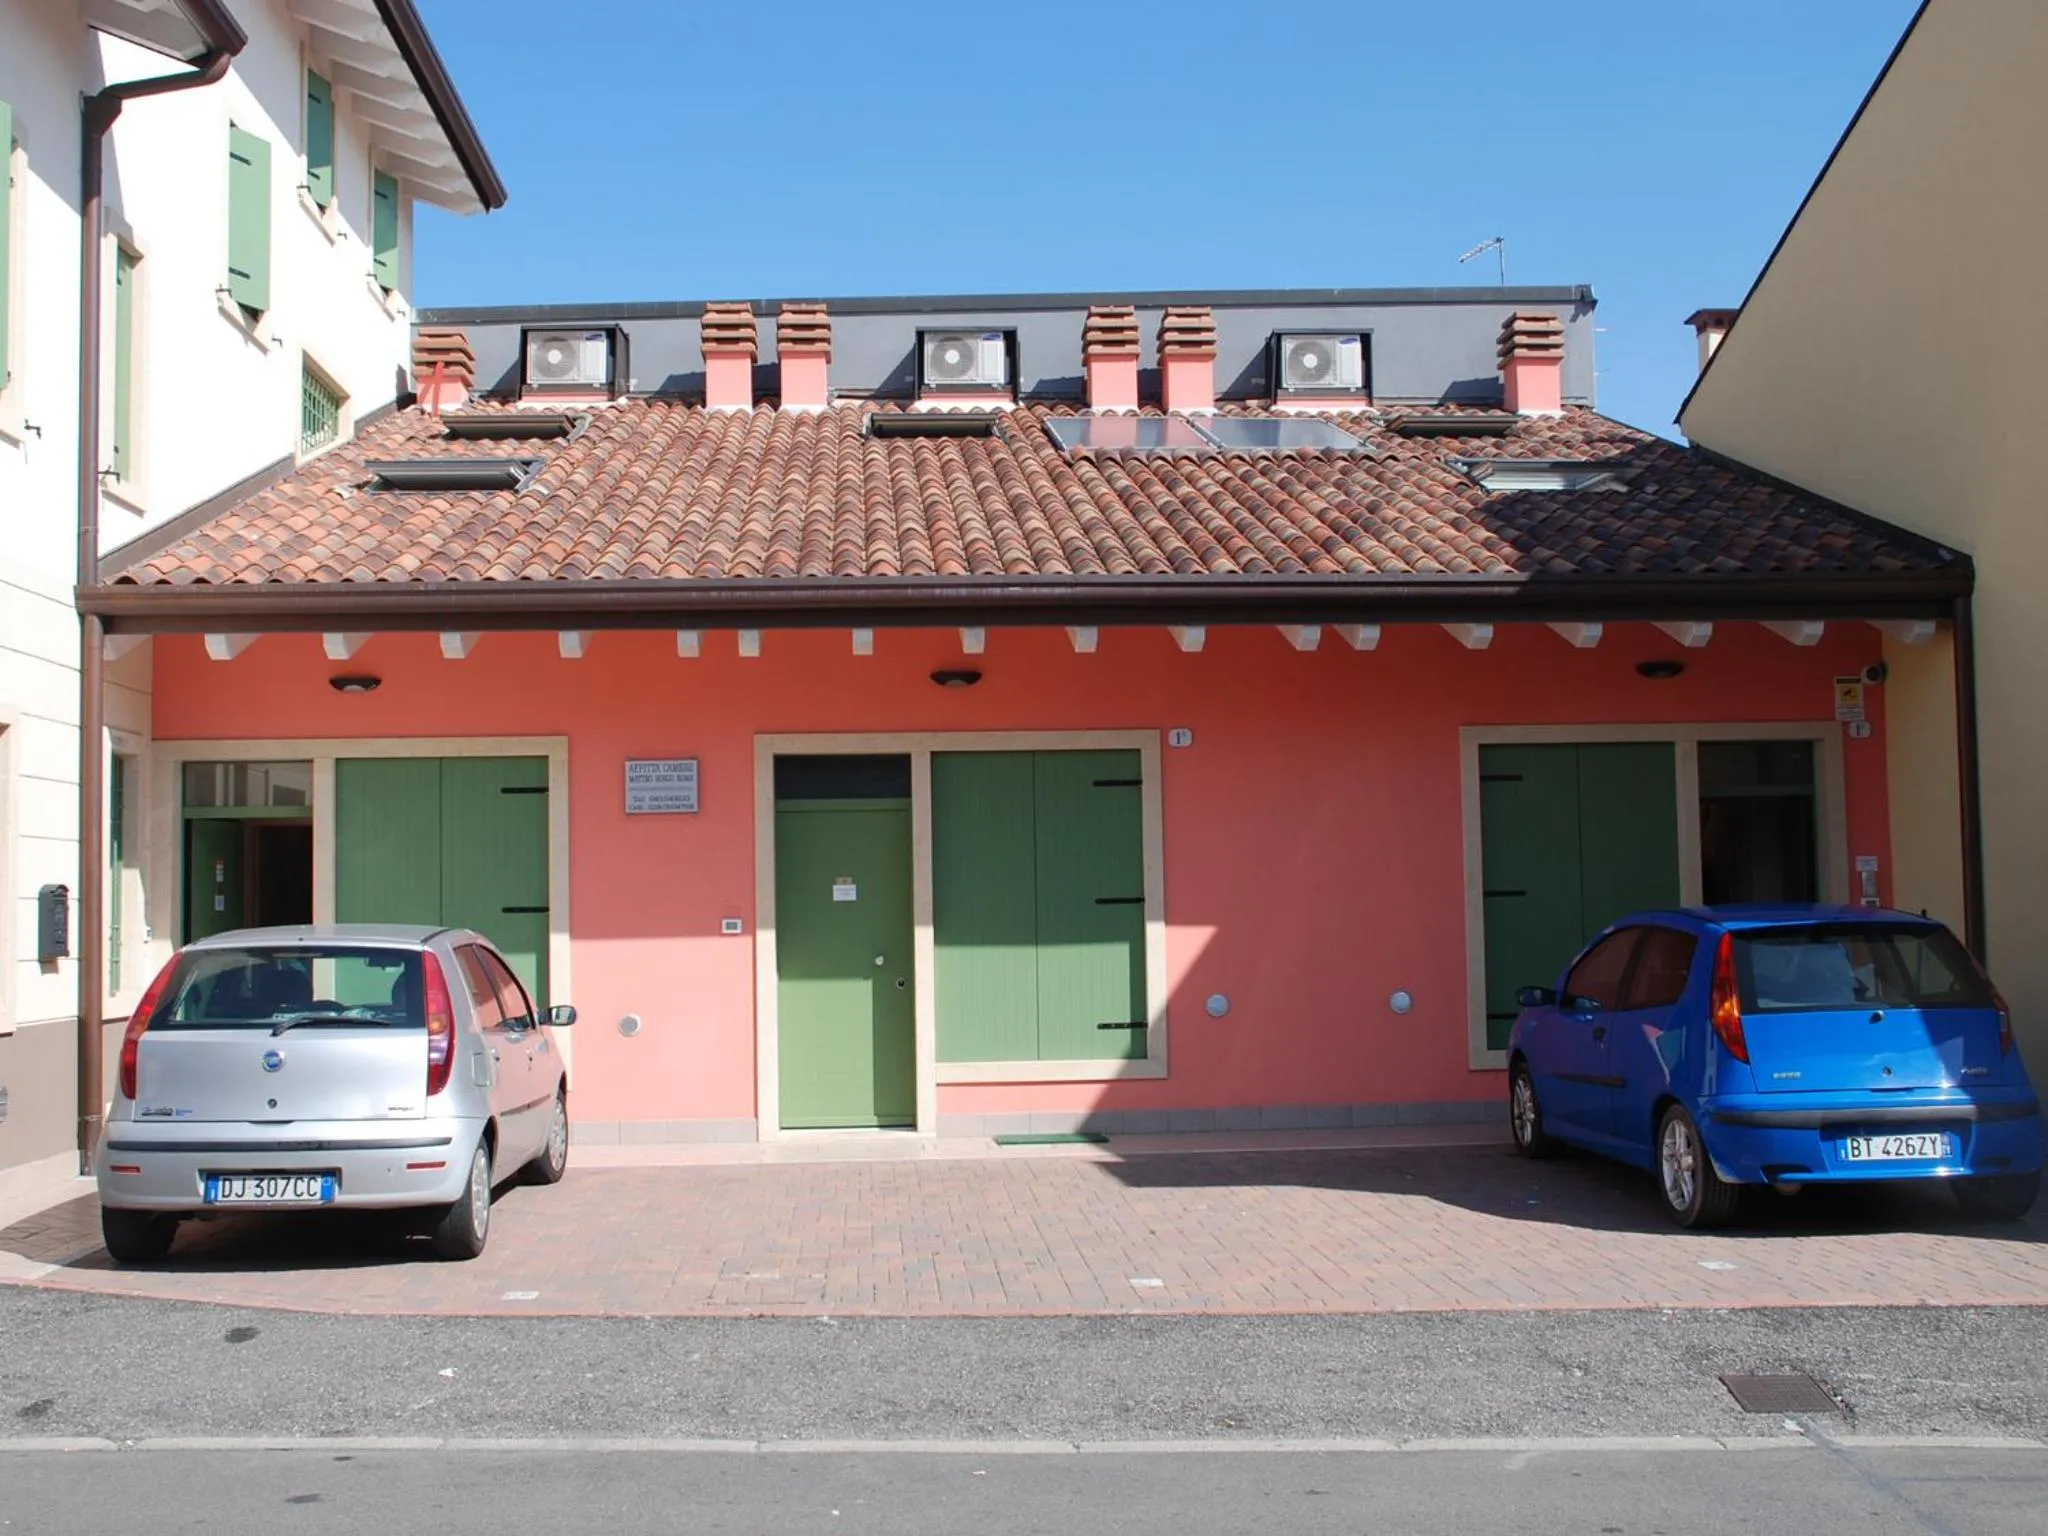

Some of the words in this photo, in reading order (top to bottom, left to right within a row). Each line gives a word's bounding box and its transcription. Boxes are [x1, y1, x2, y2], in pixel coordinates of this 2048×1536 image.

[1850, 1137, 1873, 1159] BT
[1881, 1135, 1939, 1157] 426ZY
[221, 1176, 247, 1199] DJ
[253, 1175, 319, 1198] 307CC
